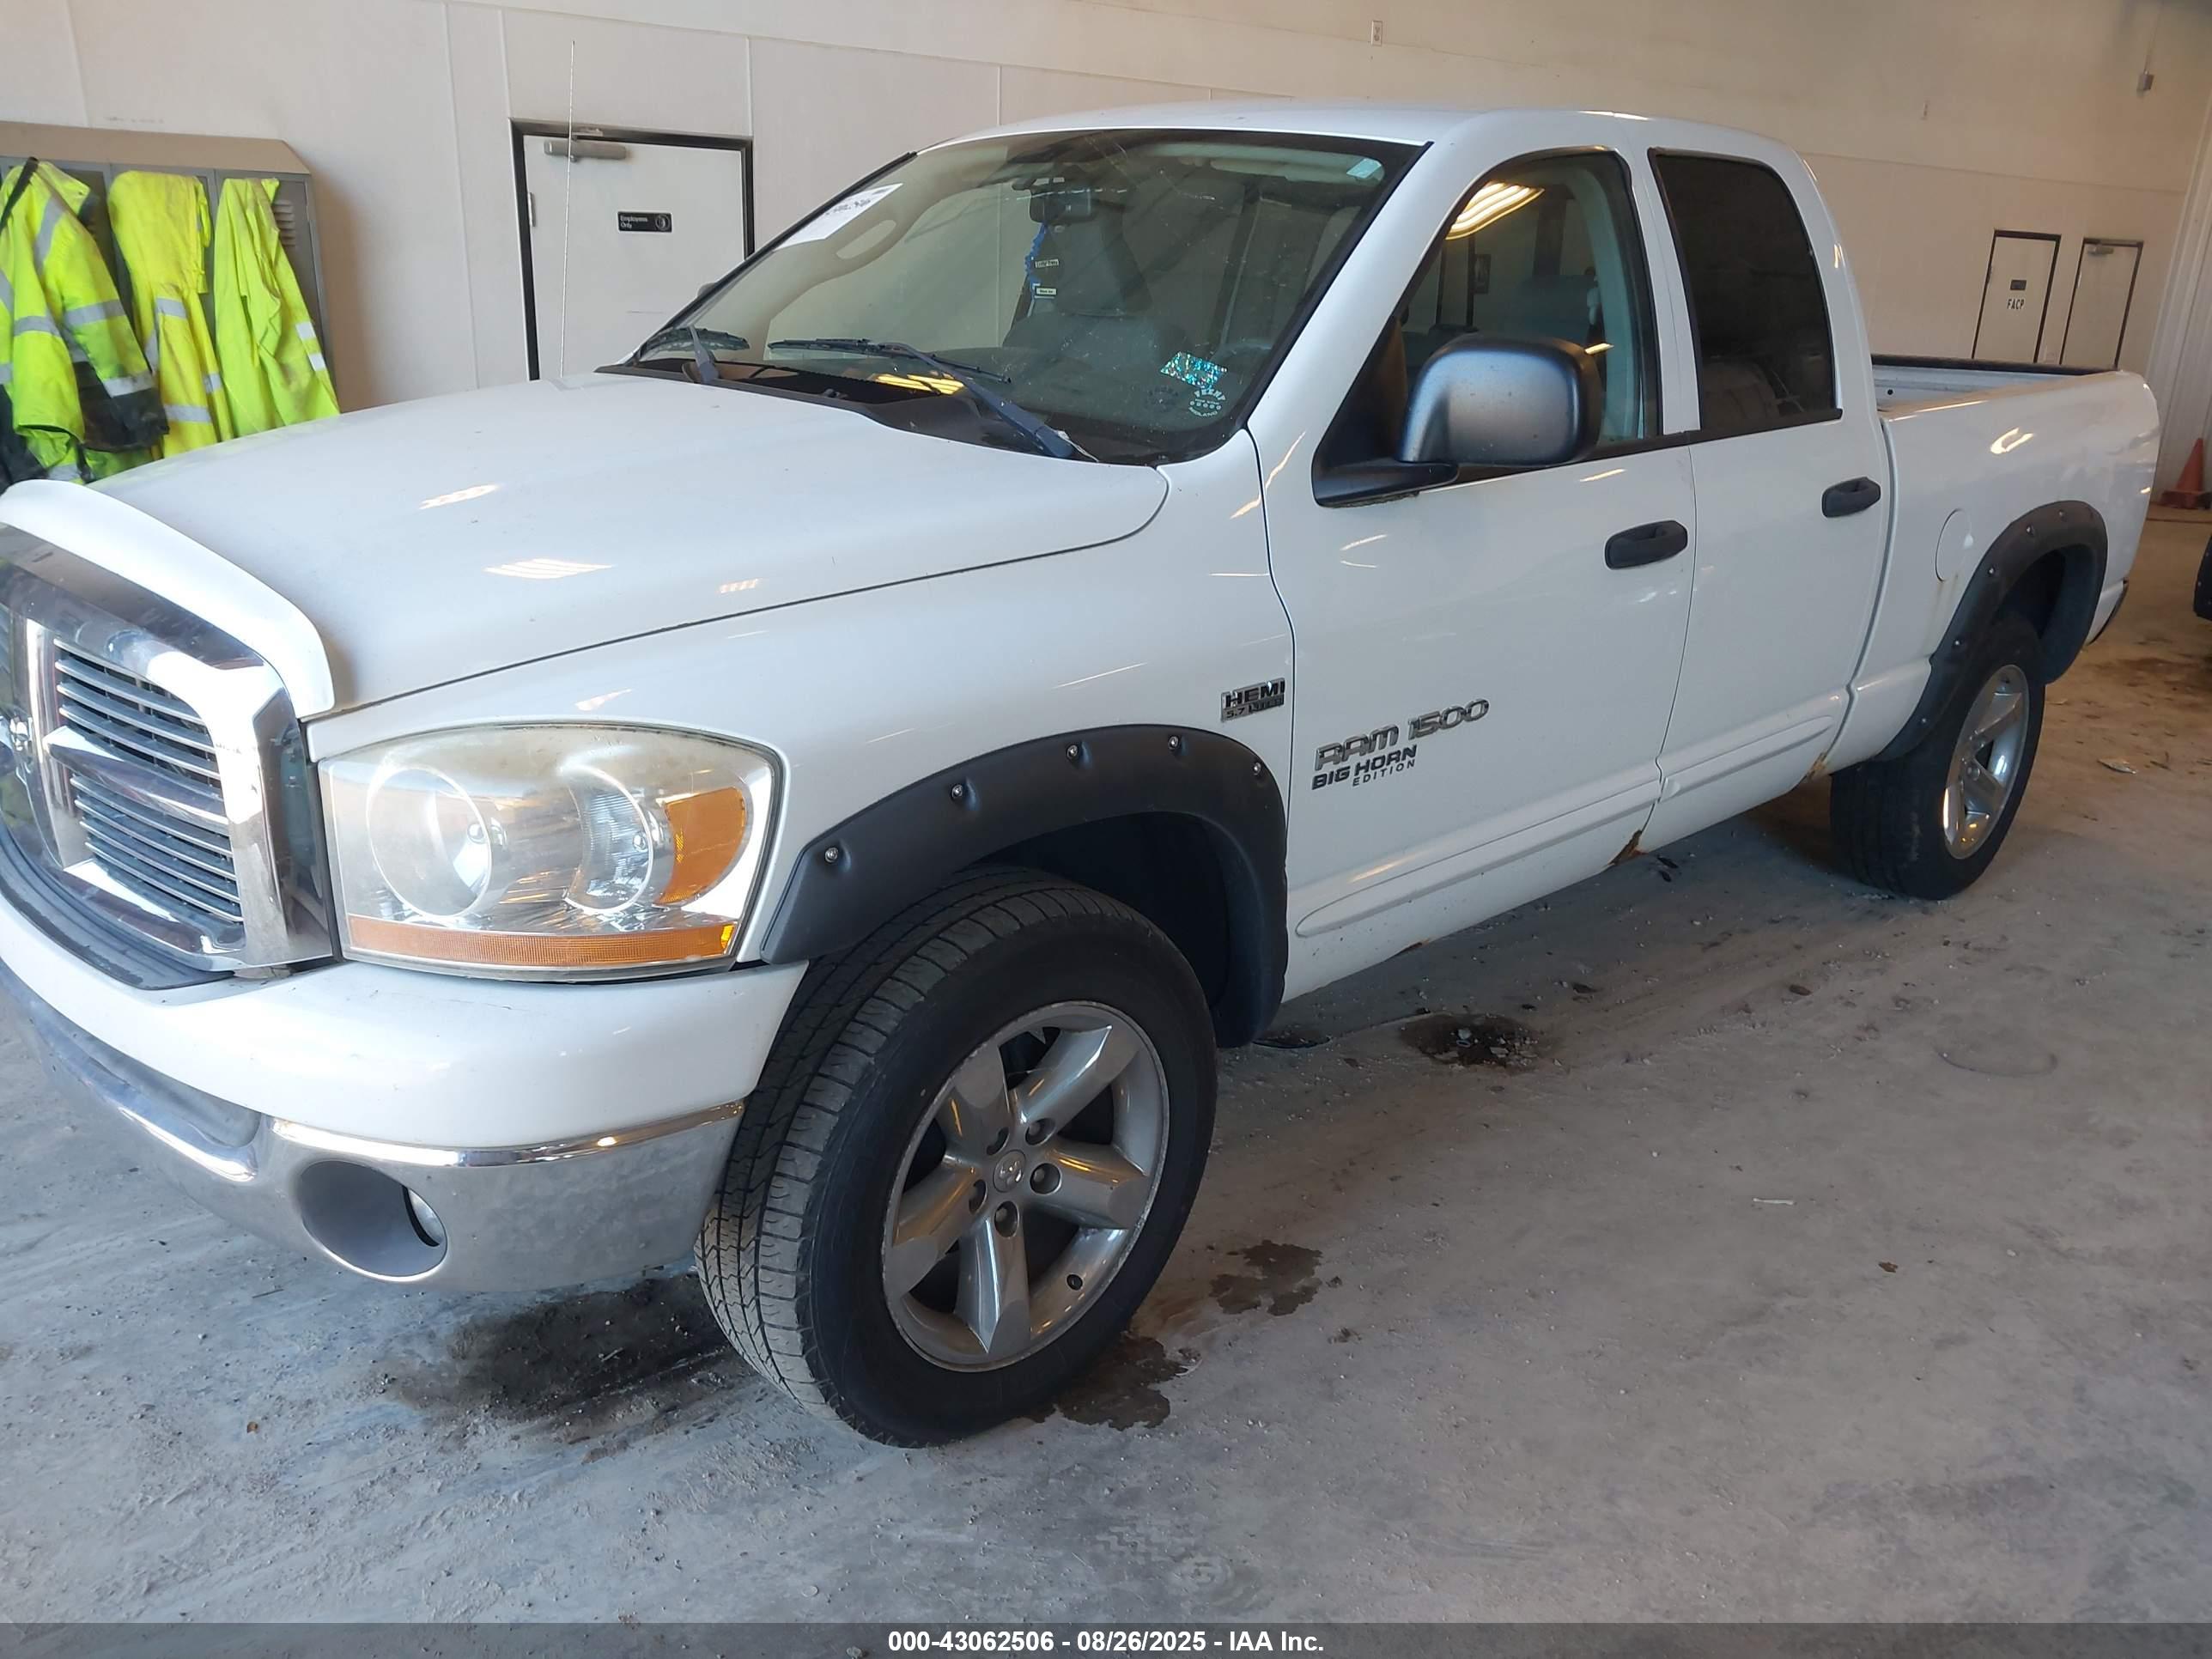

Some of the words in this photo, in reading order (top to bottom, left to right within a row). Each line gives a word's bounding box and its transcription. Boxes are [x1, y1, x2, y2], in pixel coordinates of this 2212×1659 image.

[2007, 299, 2025, 310] FACP
[1224, 679, 1285, 708] HEMI
[1226, 707, 1246, 719] 5.7
[1315, 724, 1399, 771] RAM
[1408, 698, 1490, 740] 1500
[1312, 766, 1351, 790] BIG
[1354, 744, 1417, 776] HORN
[1352, 759, 1415, 787] EDITION
